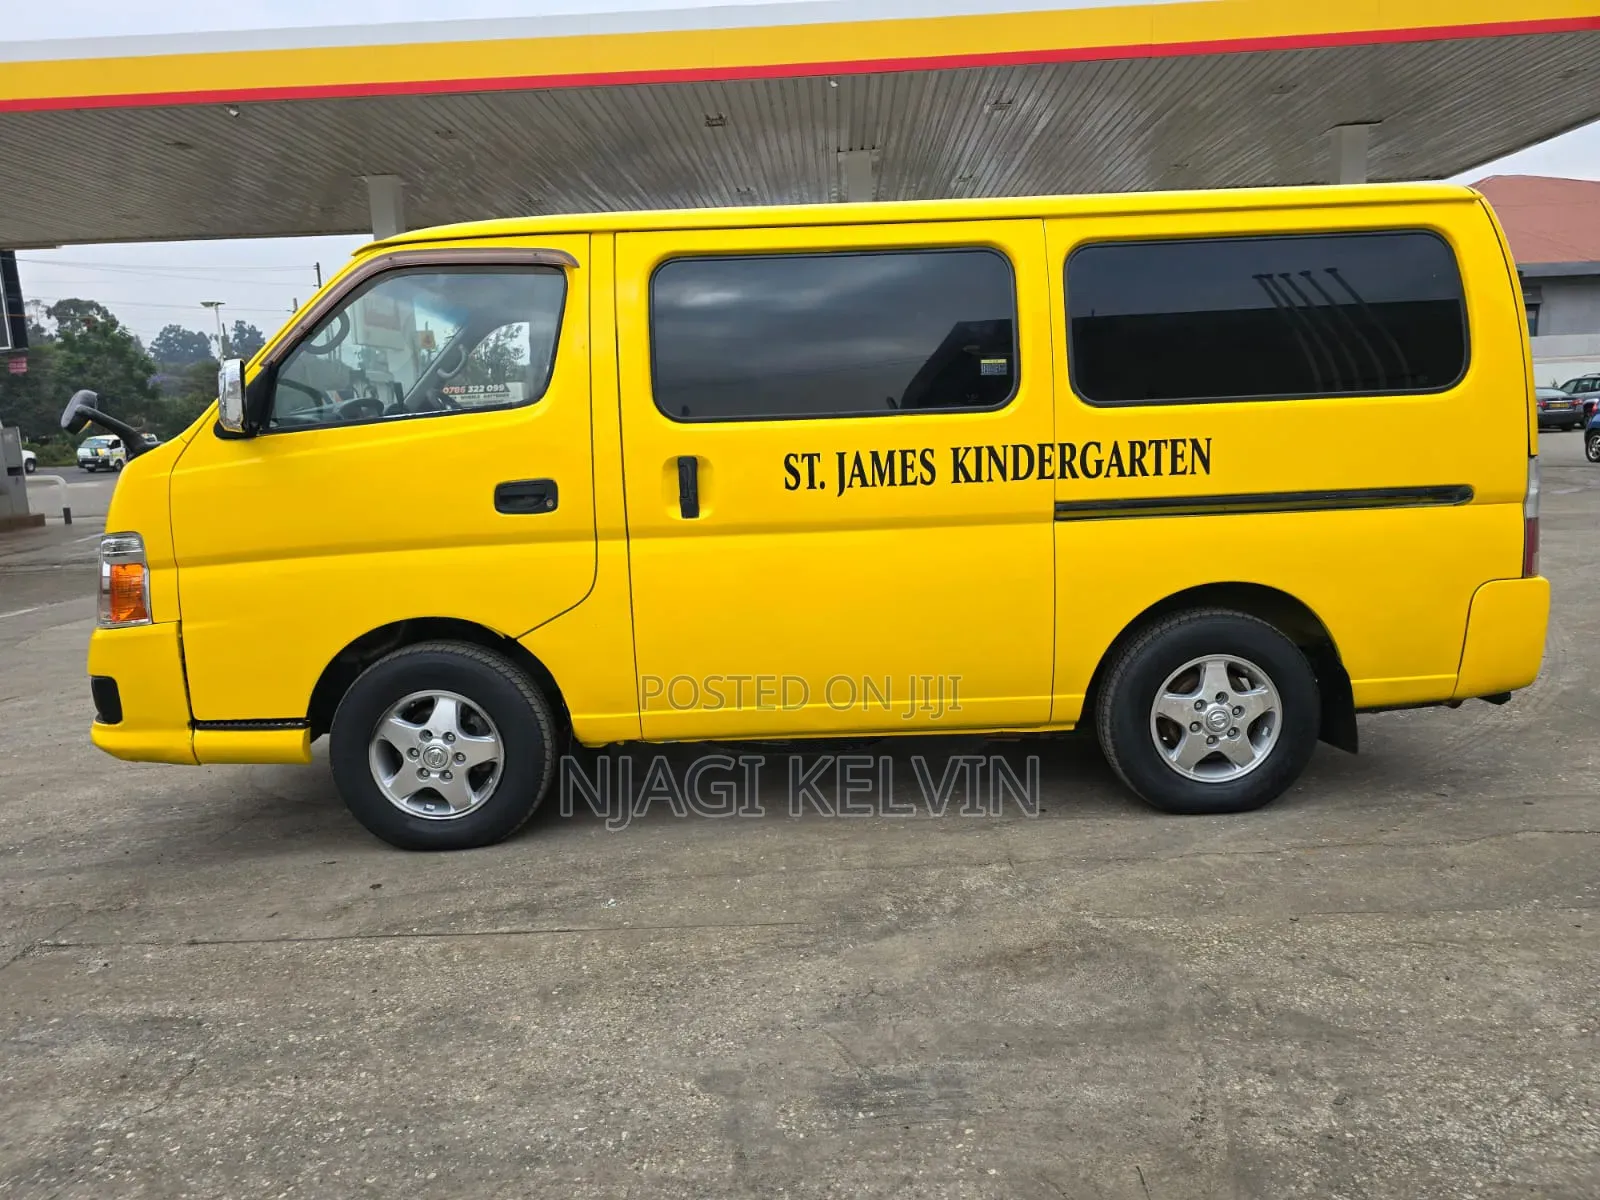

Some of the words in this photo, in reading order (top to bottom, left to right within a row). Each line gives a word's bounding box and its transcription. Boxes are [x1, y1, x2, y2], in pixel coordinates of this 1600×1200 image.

[467, 385, 485, 393] 322
[784, 452, 826, 491] ST.
[835, 448, 936, 497] JAMES
[950, 437, 1212, 484] KINDERGARTEN
